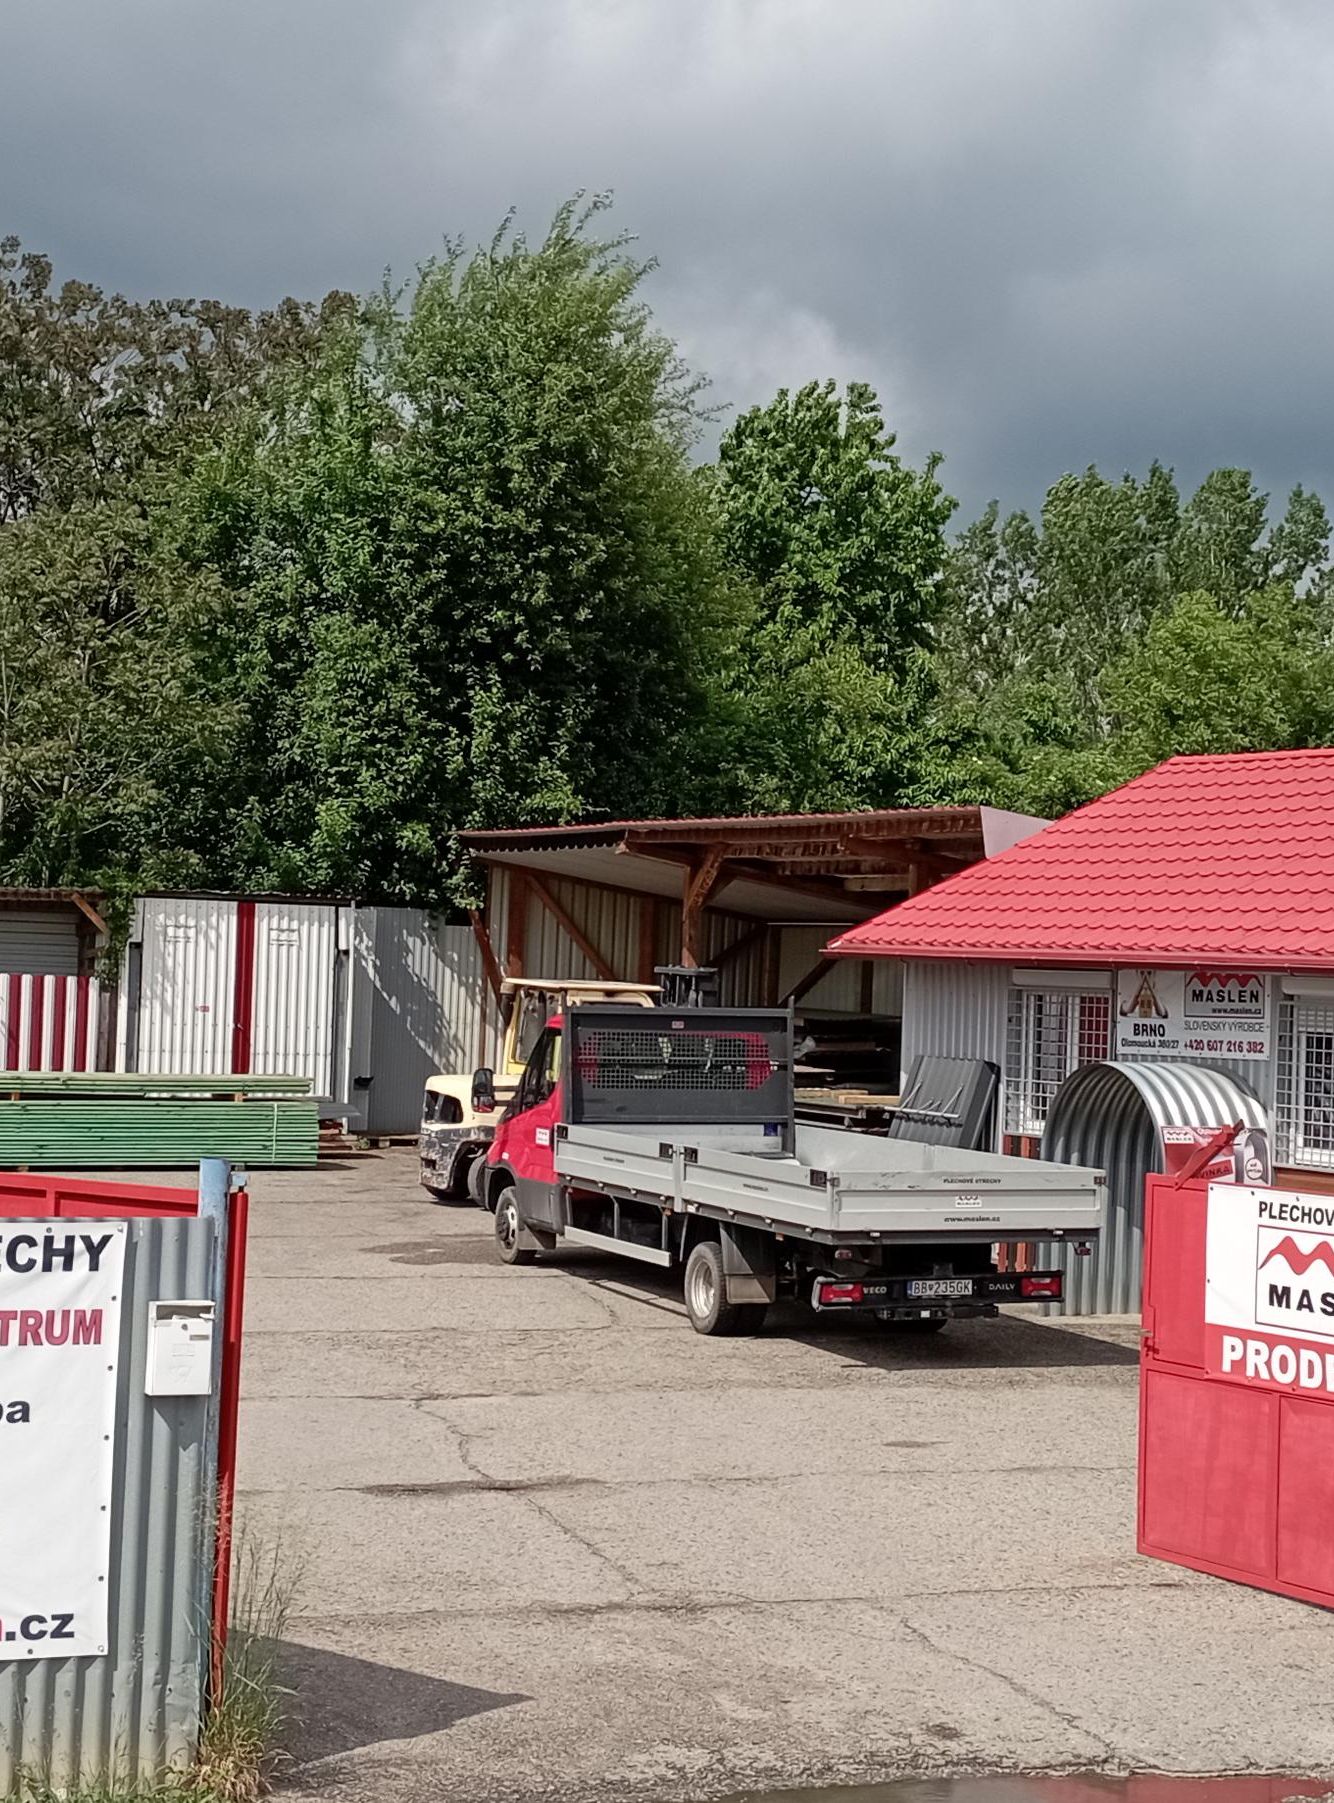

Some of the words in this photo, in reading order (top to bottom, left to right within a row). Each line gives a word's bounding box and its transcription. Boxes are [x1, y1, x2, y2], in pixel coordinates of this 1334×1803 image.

[1192, 989, 1259, 1003] MASLEN
[1133, 1023, 1166, 1037] BRNO
[1184, 1038, 1204, 1051] +420
[1226, 1041, 1244, 1053] 216
[863, 1286, 887, 1295] VECO
[988, 1283, 1016, 1291] DAILY
